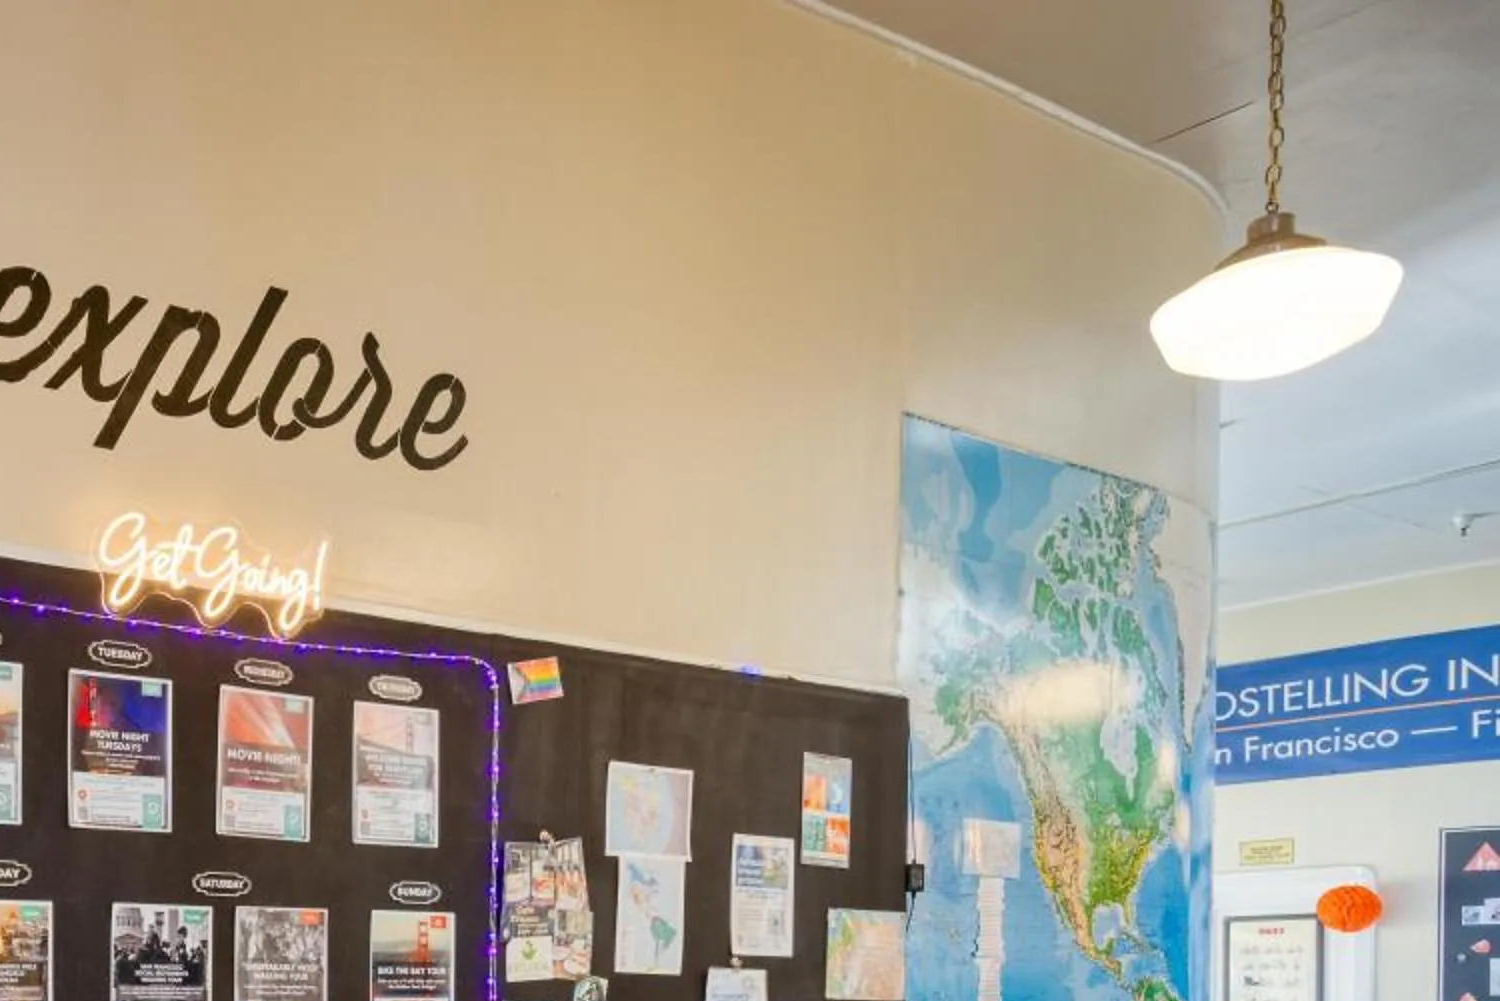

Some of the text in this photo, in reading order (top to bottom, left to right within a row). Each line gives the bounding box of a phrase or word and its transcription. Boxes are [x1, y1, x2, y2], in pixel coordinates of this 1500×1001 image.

[99, 512, 329, 637] Get Going!
[97, 647, 143, 661] TUESDAY
[1245, 727, 1399, 763] Francisco
[199, 878, 245, 889] SATURDAY
